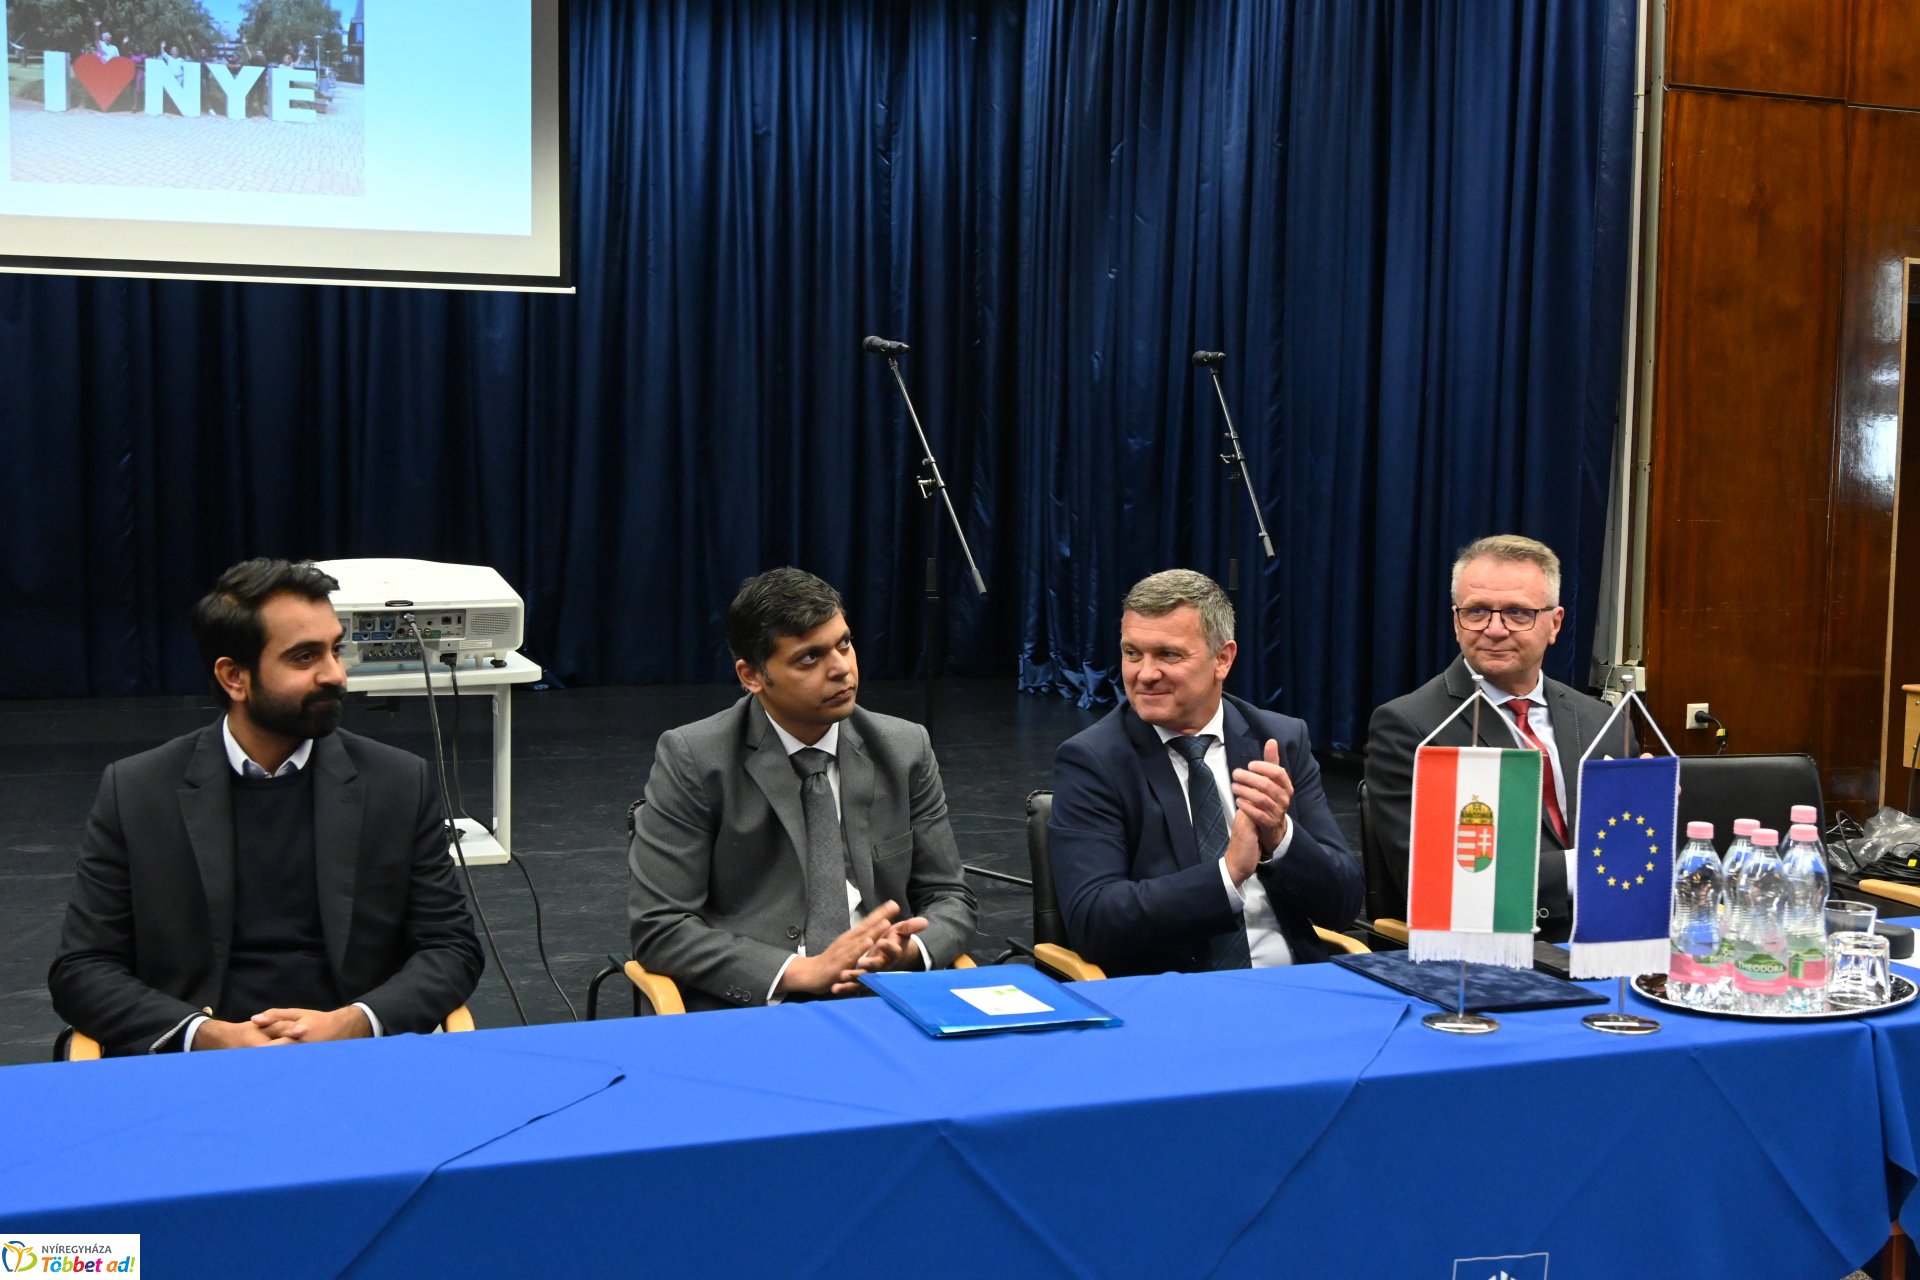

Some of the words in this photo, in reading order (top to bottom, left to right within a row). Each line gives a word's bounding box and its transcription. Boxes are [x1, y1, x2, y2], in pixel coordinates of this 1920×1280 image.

[44, 51, 70, 112] I
[144, 58, 317, 123] NYE
[1738, 960, 1784, 973] THEODORA
